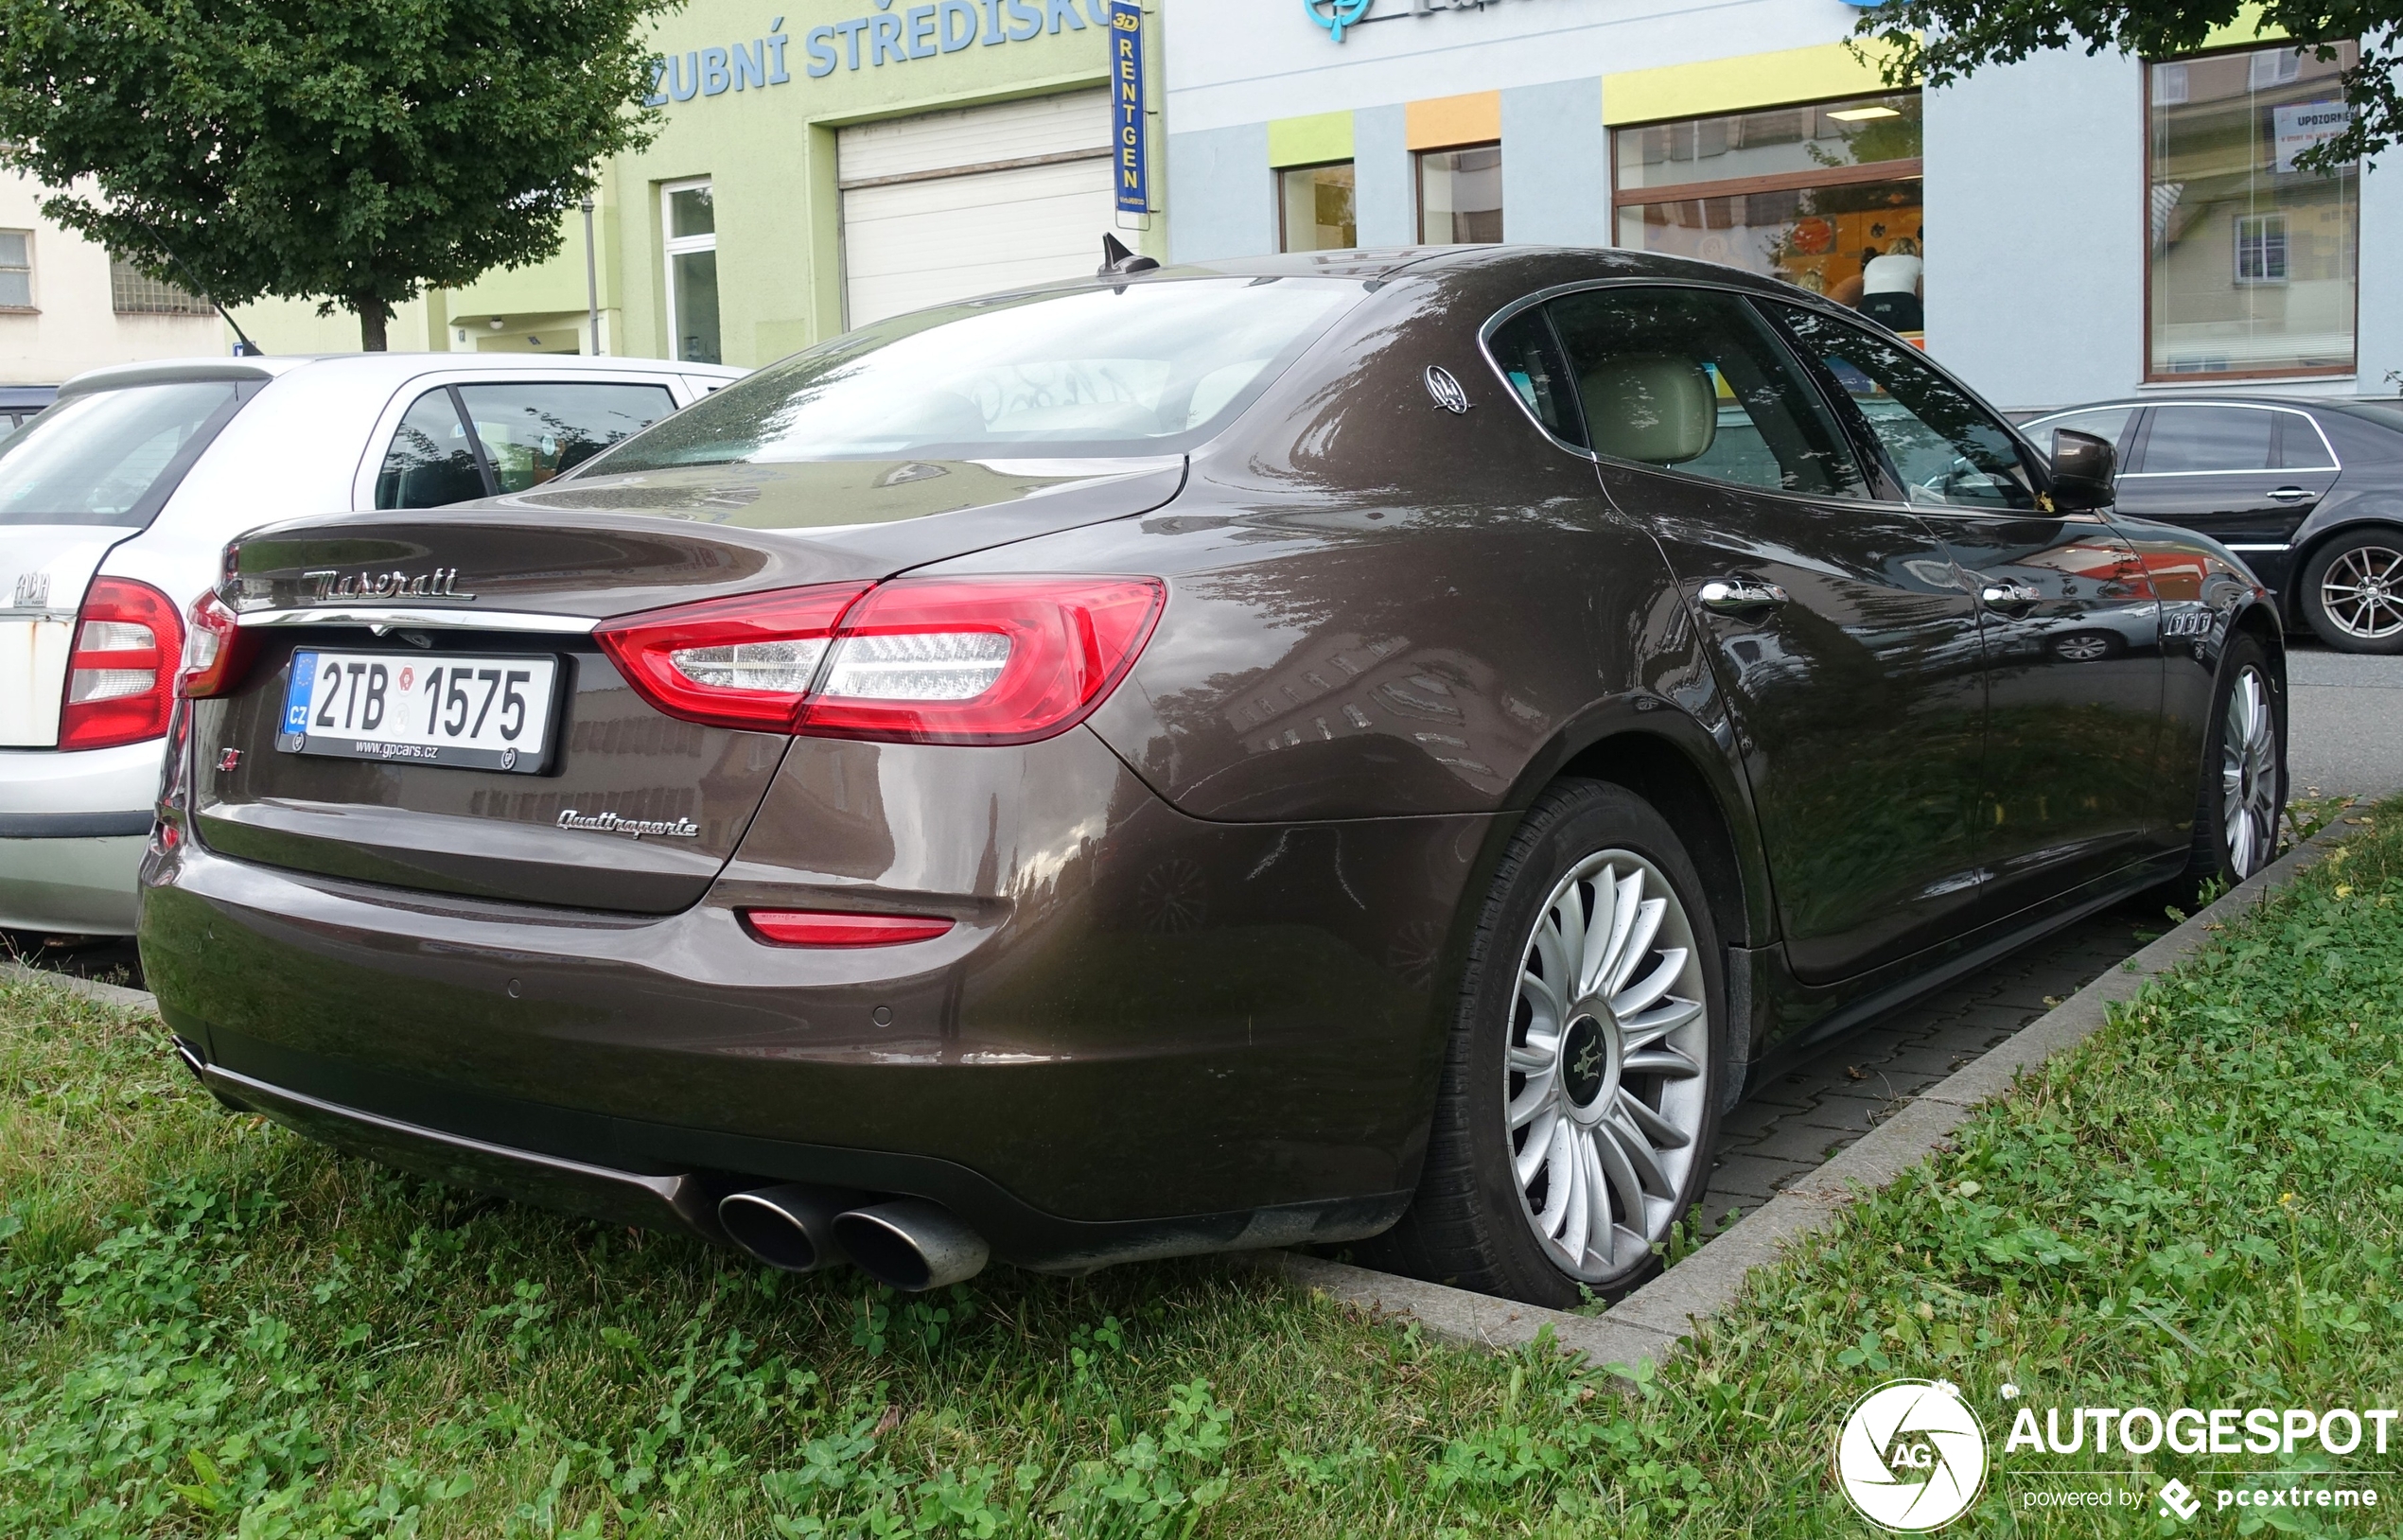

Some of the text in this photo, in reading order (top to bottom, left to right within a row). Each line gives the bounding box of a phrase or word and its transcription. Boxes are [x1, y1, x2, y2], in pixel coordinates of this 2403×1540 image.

[1113, 12, 1140, 32] 3D
[1119, 38, 1138, 189] RENTGEN
[302, 568, 478, 601] Maserati
[289, 706, 307, 726] CZ
[316, 662, 531, 741] 2TB 1575
[356, 741, 439, 759] www.gpcars.cz
[556, 809, 700, 840] Quattroporte
